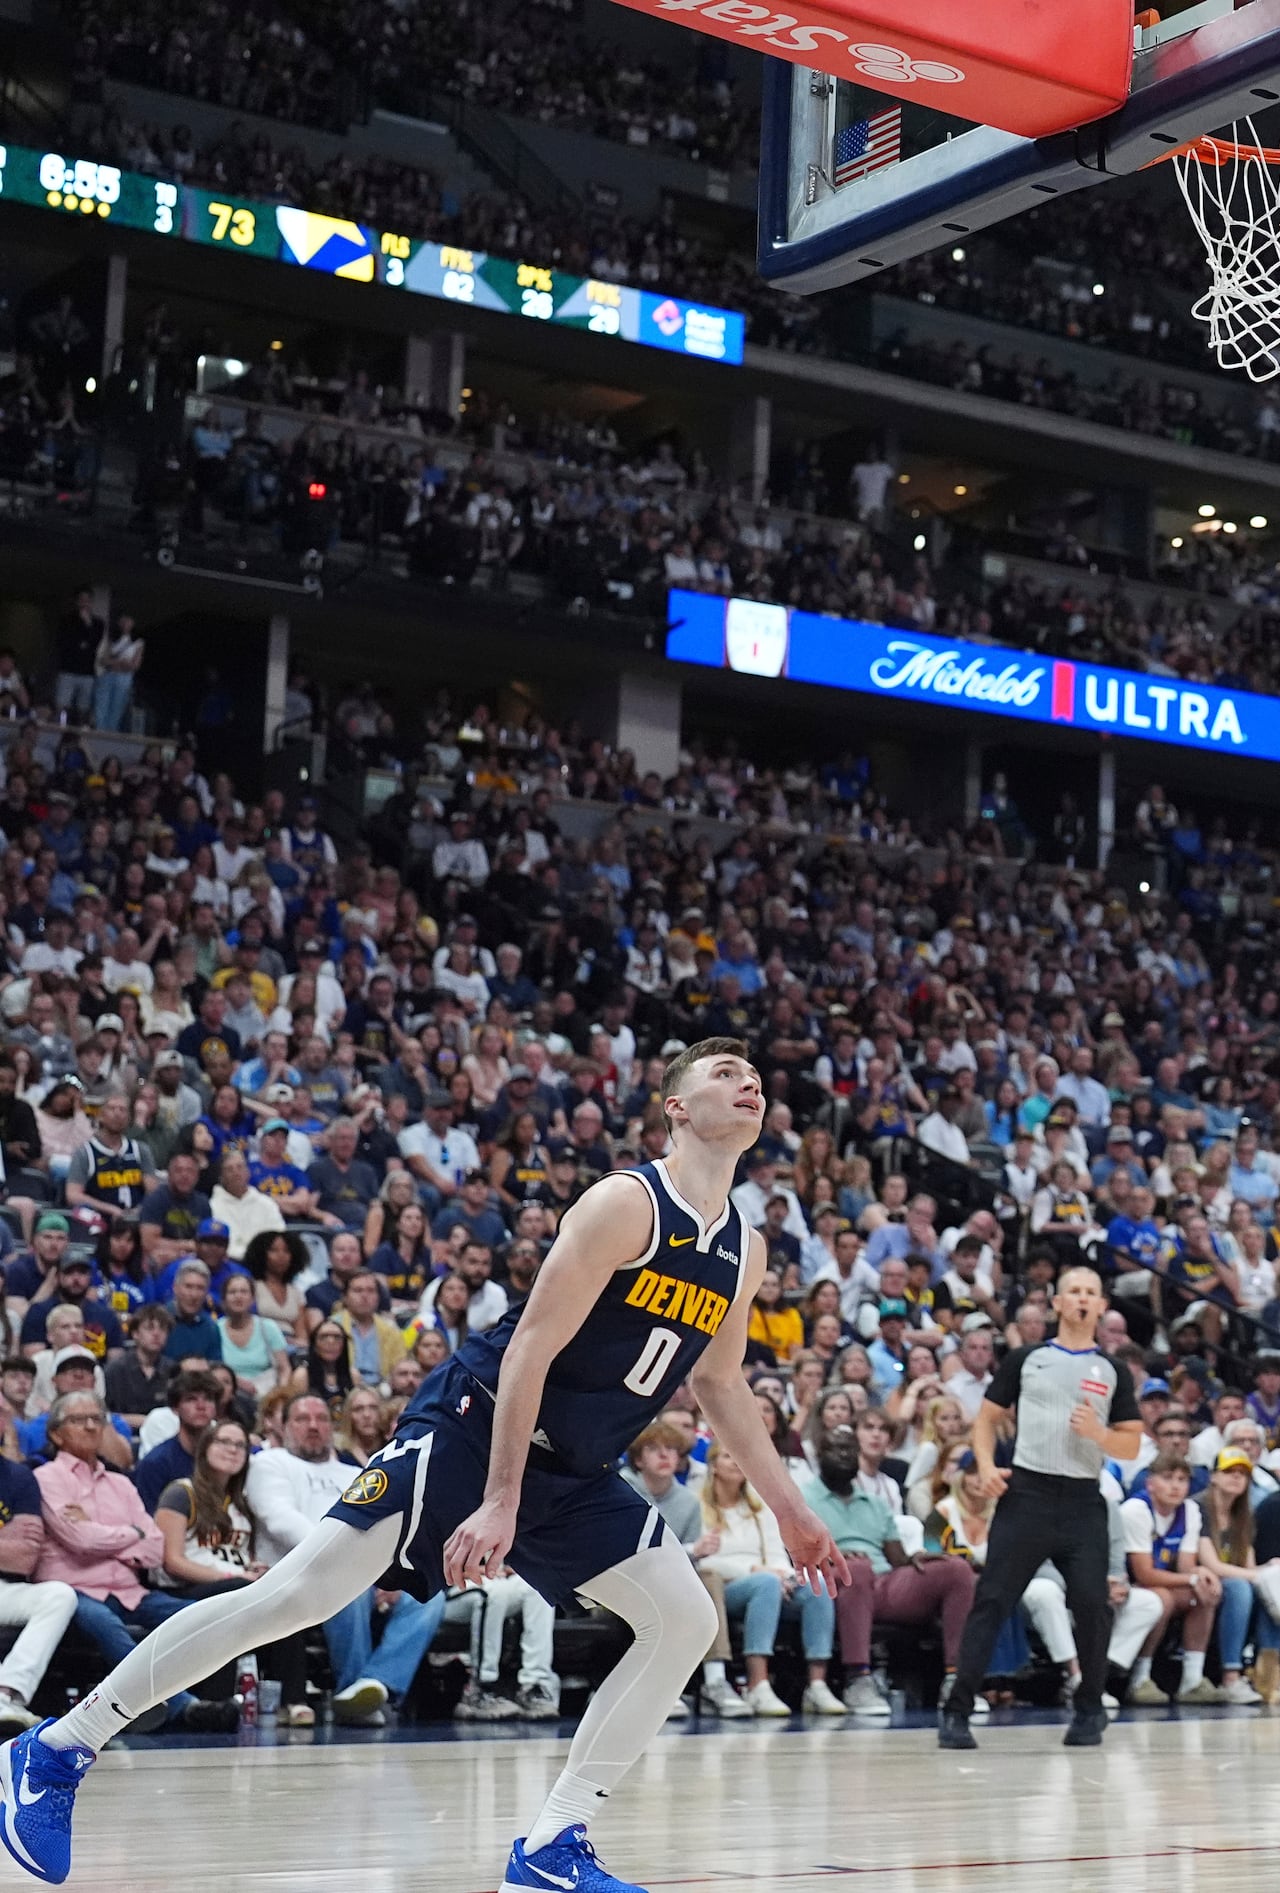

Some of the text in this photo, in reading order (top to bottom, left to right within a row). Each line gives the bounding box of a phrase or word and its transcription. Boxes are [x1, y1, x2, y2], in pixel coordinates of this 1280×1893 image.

[40, 153, 121, 204] 6:55
[154, 205, 174, 233] 3
[208, 202, 255, 246] 73
[386, 258, 404, 286] 3
[869, 640, 1048, 708] Michelob
[1084, 674, 1243, 744] ULTRA
[716, 1245, 738, 1266] ibotta
[624, 1268, 730, 1337] DENVER
[624, 1326, 683, 1397] 0
